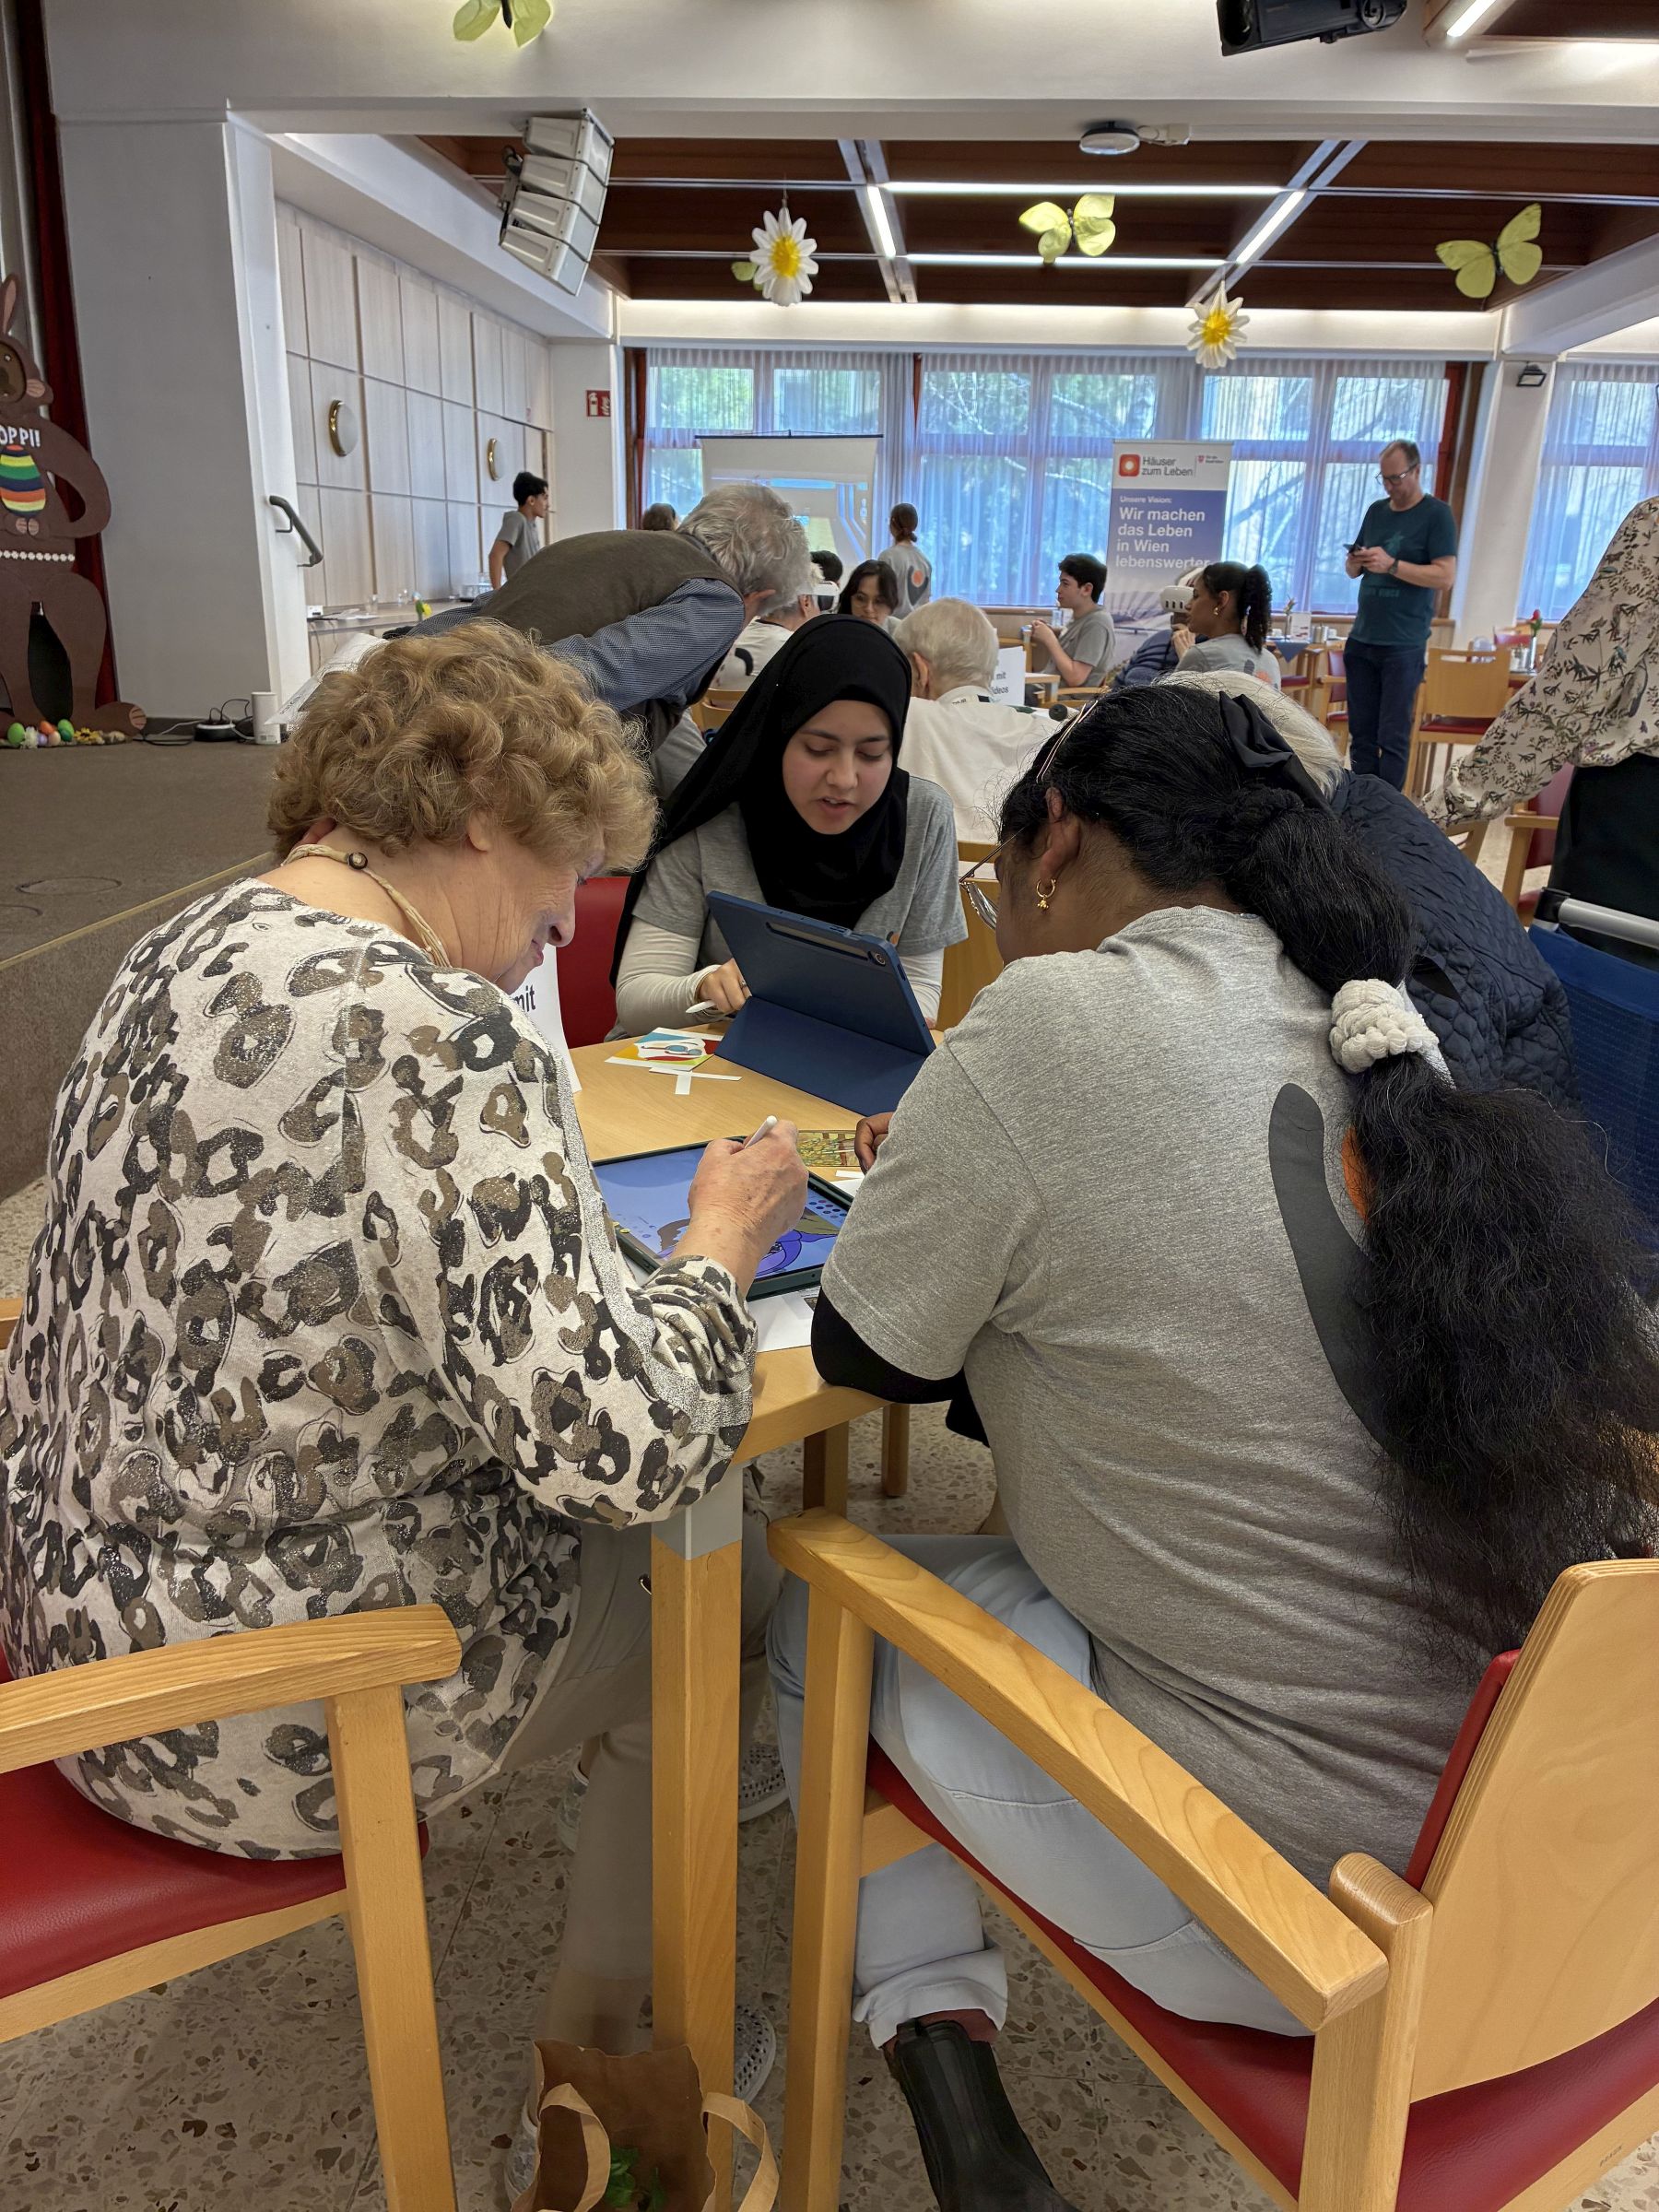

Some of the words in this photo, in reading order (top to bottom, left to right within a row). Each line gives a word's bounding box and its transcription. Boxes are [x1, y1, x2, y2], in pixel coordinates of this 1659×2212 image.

[1142, 456, 1176, 465] Häuser
[1142, 467, 1161, 476] zum
[1163, 465, 1194, 477] Leben
[1119, 506, 1144, 521] Wir
[1147, 508, 1206, 522] machen
[1117, 523, 1144, 536] das
[1148, 523, 1193, 537] Leben
[1116, 538, 1130, 552] in
[1134, 538, 1170, 552] Wien
